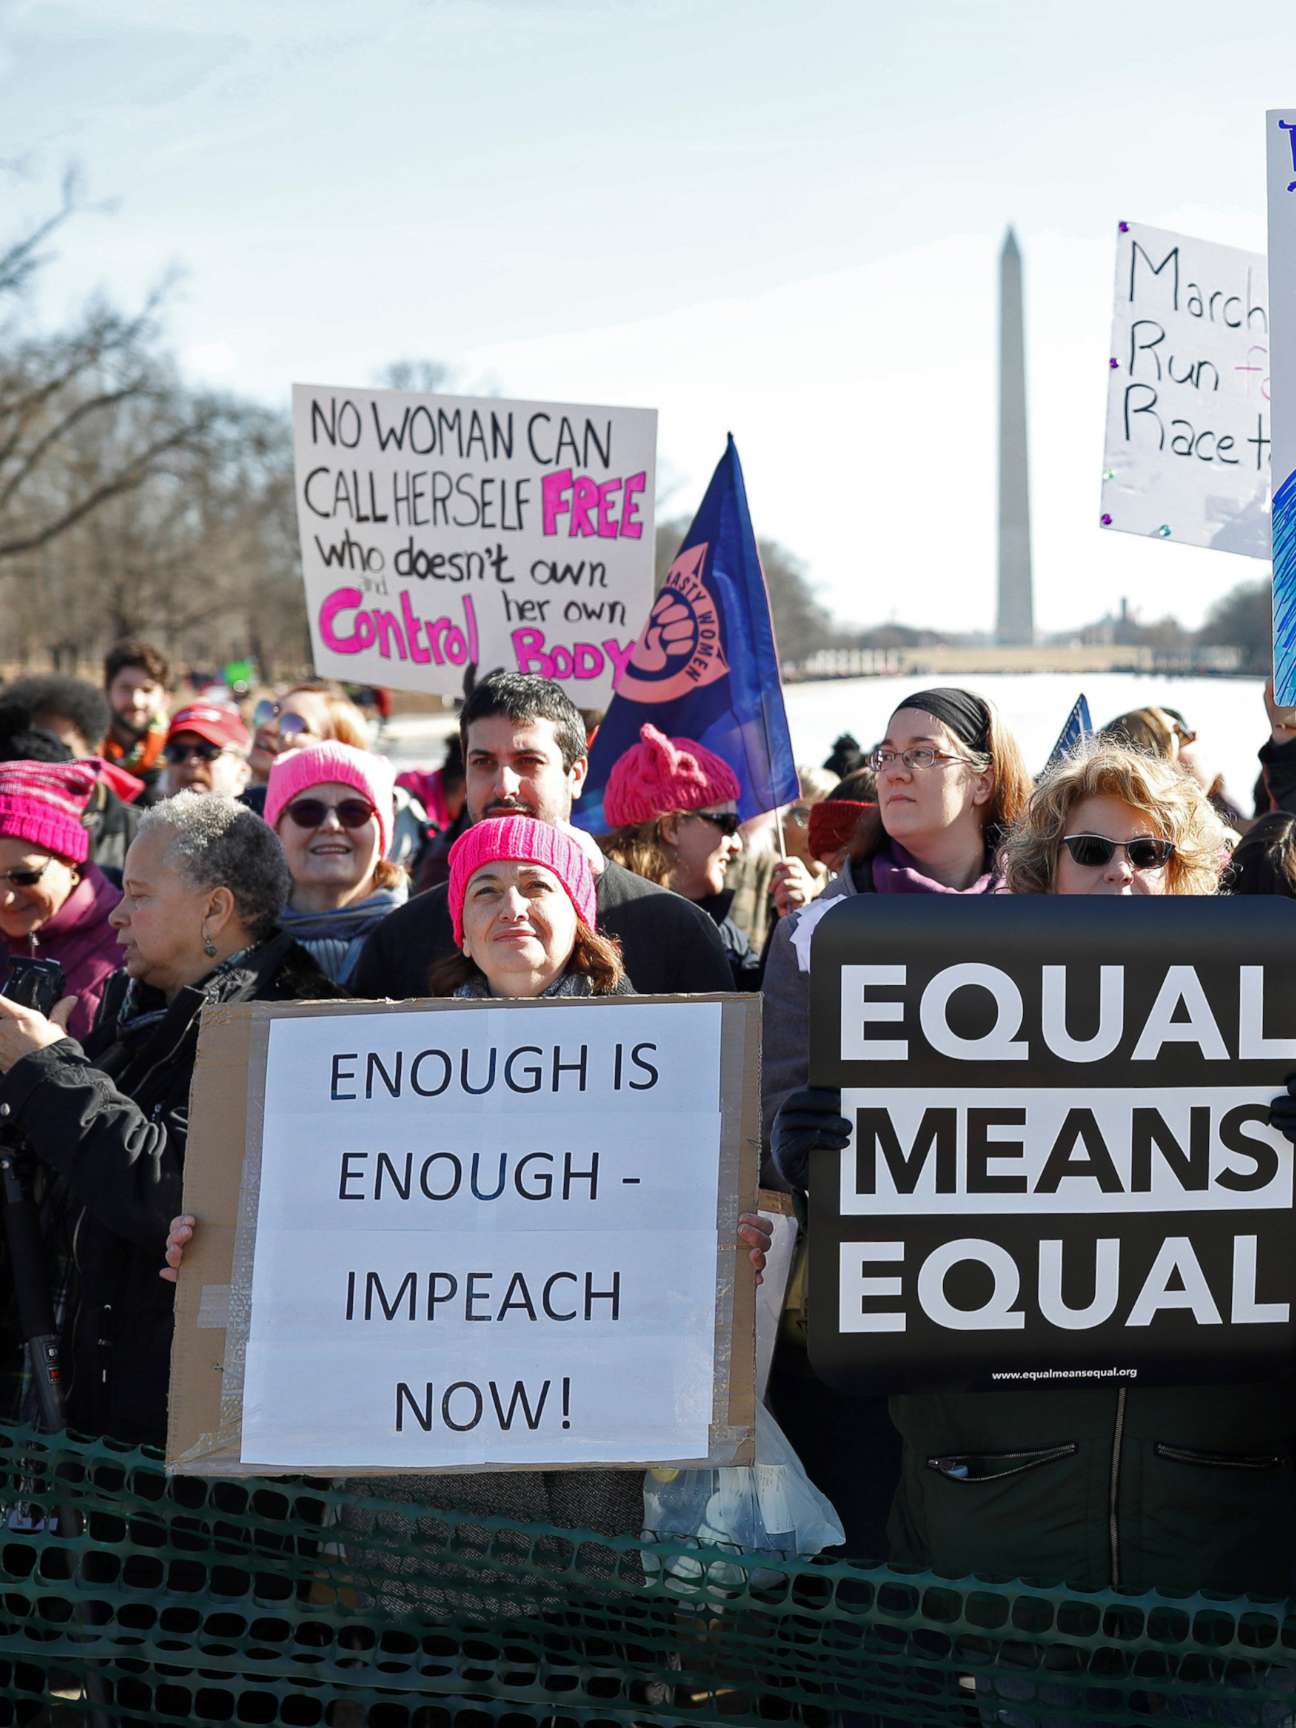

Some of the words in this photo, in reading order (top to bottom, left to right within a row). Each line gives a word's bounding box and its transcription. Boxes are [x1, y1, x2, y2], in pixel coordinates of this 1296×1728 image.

[1128, 240, 1268, 335] March
[1129, 320, 1220, 391] Run
[310, 400, 362, 448] NO
[371, 401, 514, 462] WOMAN
[528, 412, 612, 469] CAN
[1124, 383, 1240, 464] Race
[303, 467, 388, 523] CALL
[394, 471, 532, 530] HERSELF
[540, 467, 648, 540] FREE
[314, 528, 385, 572] who
[395, 536, 515, 583] doesn't
[530, 556, 608, 588] own
[318, 586, 480, 666] Control
[502, 590, 550, 623] her
[564, 600, 626, 627] own
[511, 626, 638, 690] BODY
[685, 610, 717, 683] WOMEN
[329, 1044, 589, 1101] ENOUGH
[612, 1042, 660, 1092] IS
[338, 1151, 600, 1201] ENOUGH
[855, 1103, 1280, 1196] MEANS
[345, 1270, 621, 1322] IMPEACH
[838, 1234, 1291, 1334] EQUAL
[394, 1377, 572, 1433] NOW!
[991, 1366, 1138, 1381] www.equalmeansequal.org
